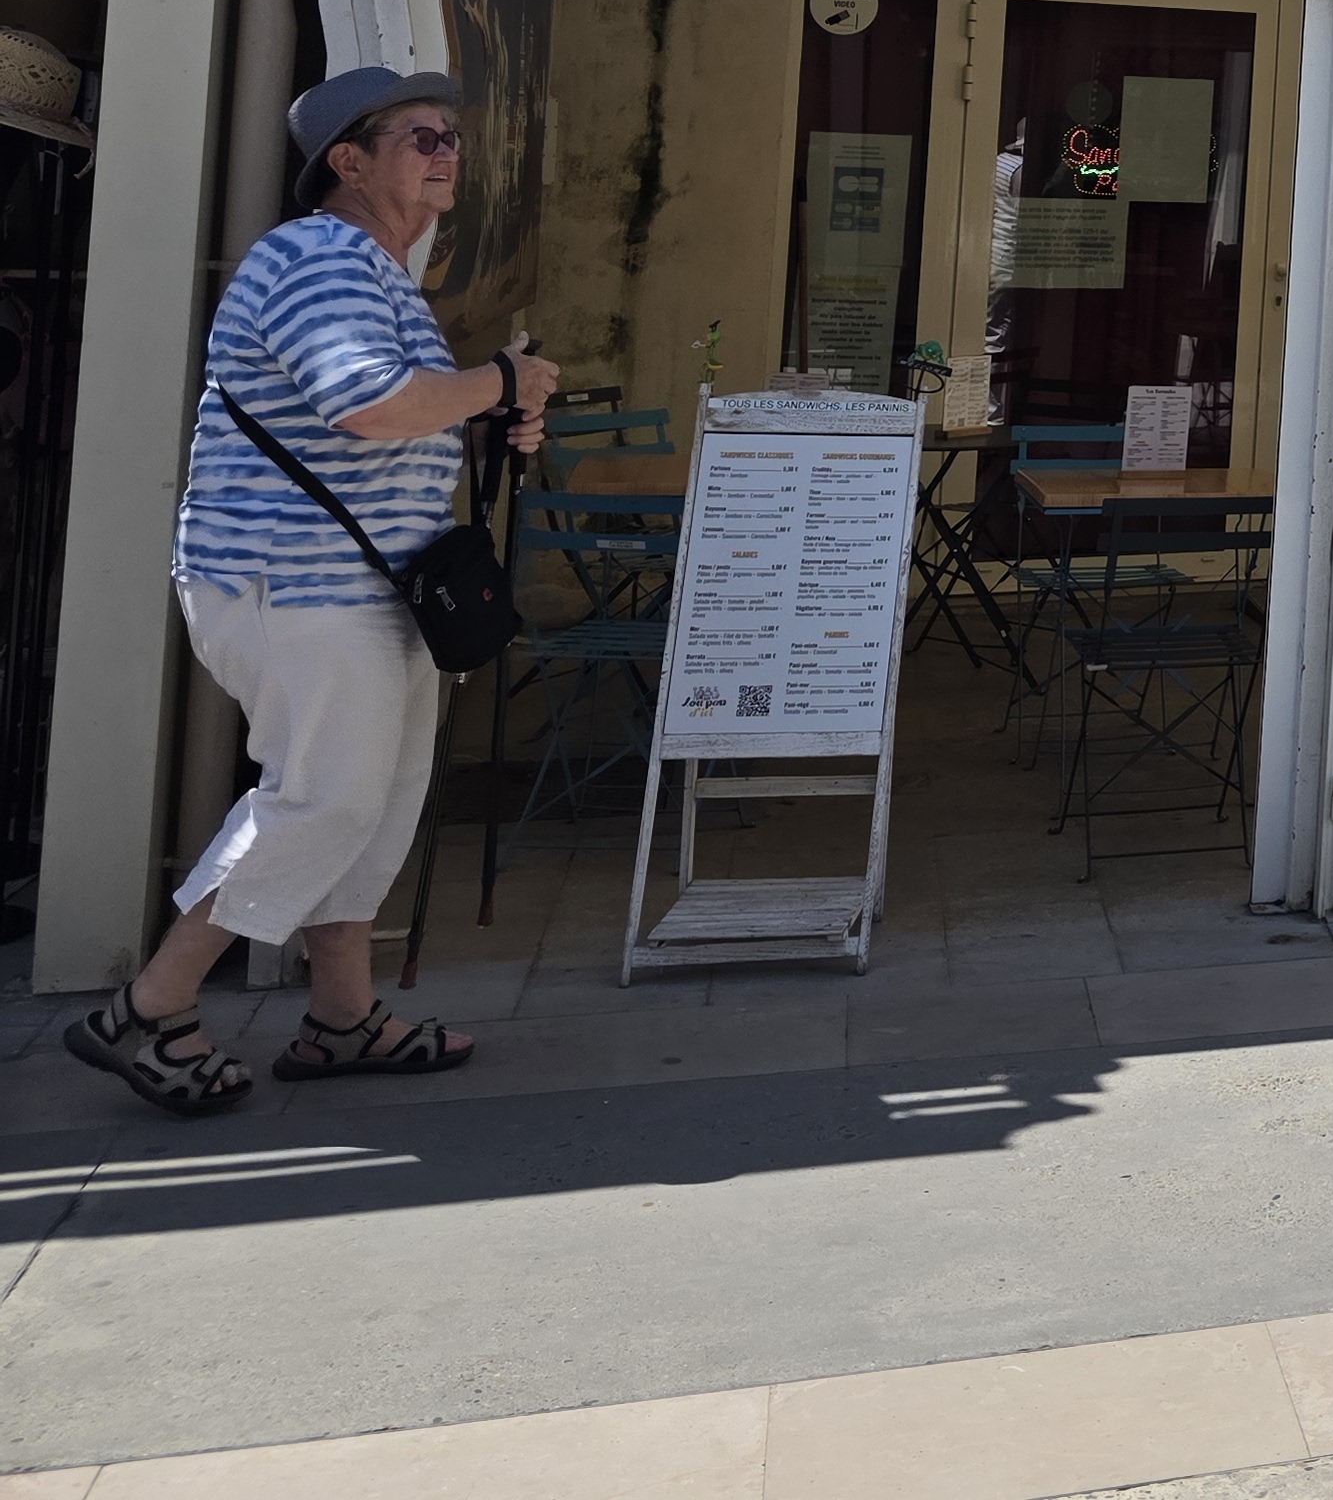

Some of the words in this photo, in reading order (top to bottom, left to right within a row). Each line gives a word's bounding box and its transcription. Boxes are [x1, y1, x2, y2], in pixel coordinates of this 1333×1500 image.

[722, 399, 751, 408] TOUS
[753, 400, 774, 409] LES
[845, 402, 866, 411] LES
[867, 403, 910, 412] PANINIS
